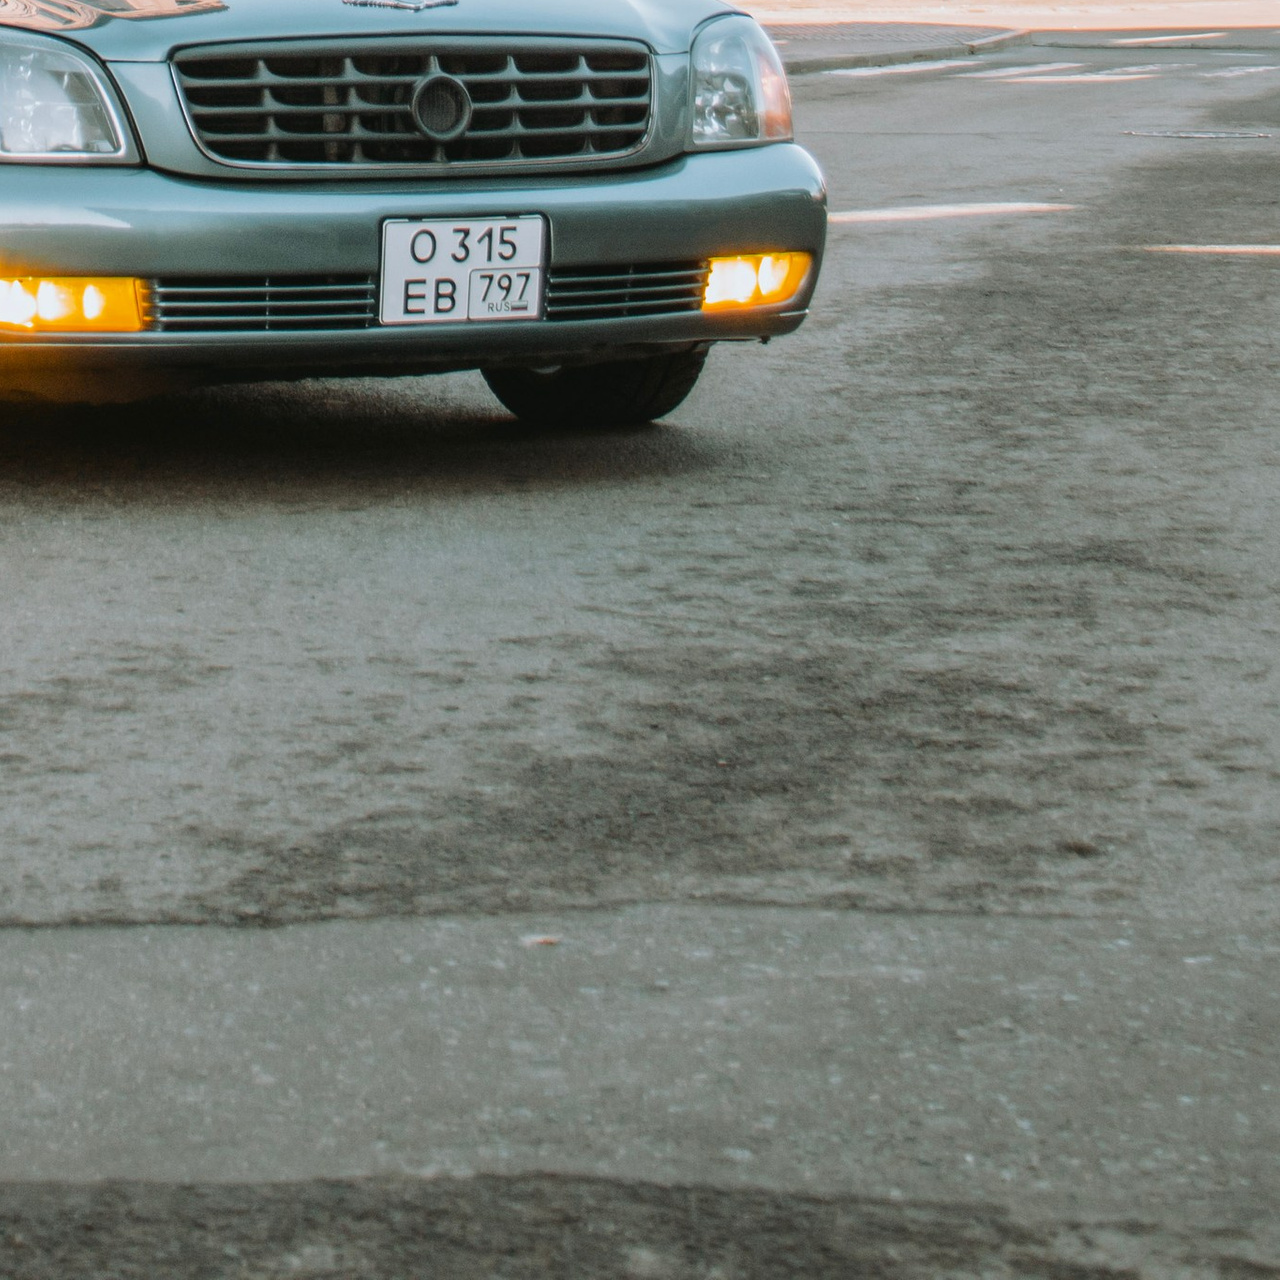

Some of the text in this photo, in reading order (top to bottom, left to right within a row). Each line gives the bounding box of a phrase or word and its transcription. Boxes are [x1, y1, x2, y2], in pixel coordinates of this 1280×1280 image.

[451, 226, 518, 262] 315
[479, 273, 531, 302] 797
[487, 302, 510, 312] RUS
